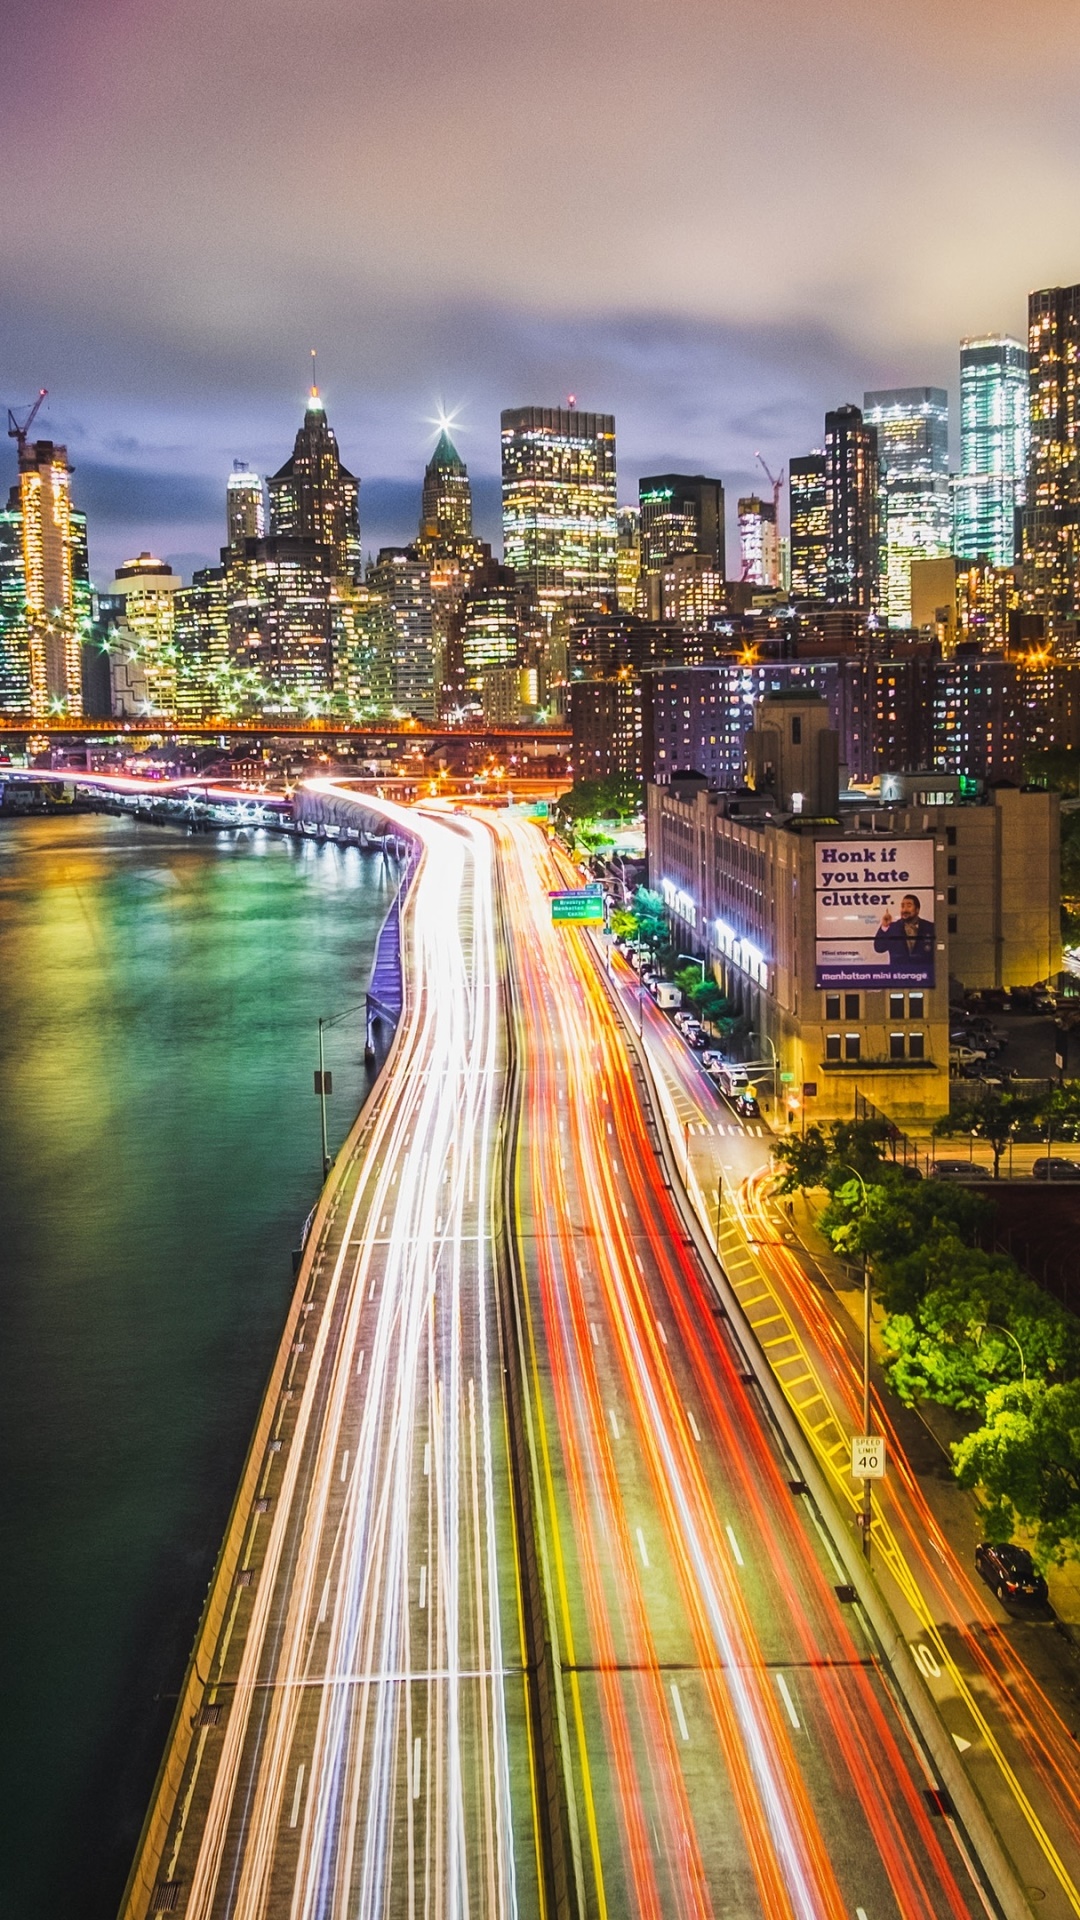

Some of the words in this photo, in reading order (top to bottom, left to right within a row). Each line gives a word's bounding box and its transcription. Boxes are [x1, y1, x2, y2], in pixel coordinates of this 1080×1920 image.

[822, 849, 876, 863] Honk
[881, 848, 897, 863] if
[822, 872, 859, 886] you
[864, 869, 910, 882] hate
[822, 893, 895, 906] clutter.
[822, 971, 871, 980] manhattan
[859, 1457, 878, 1468] 40
